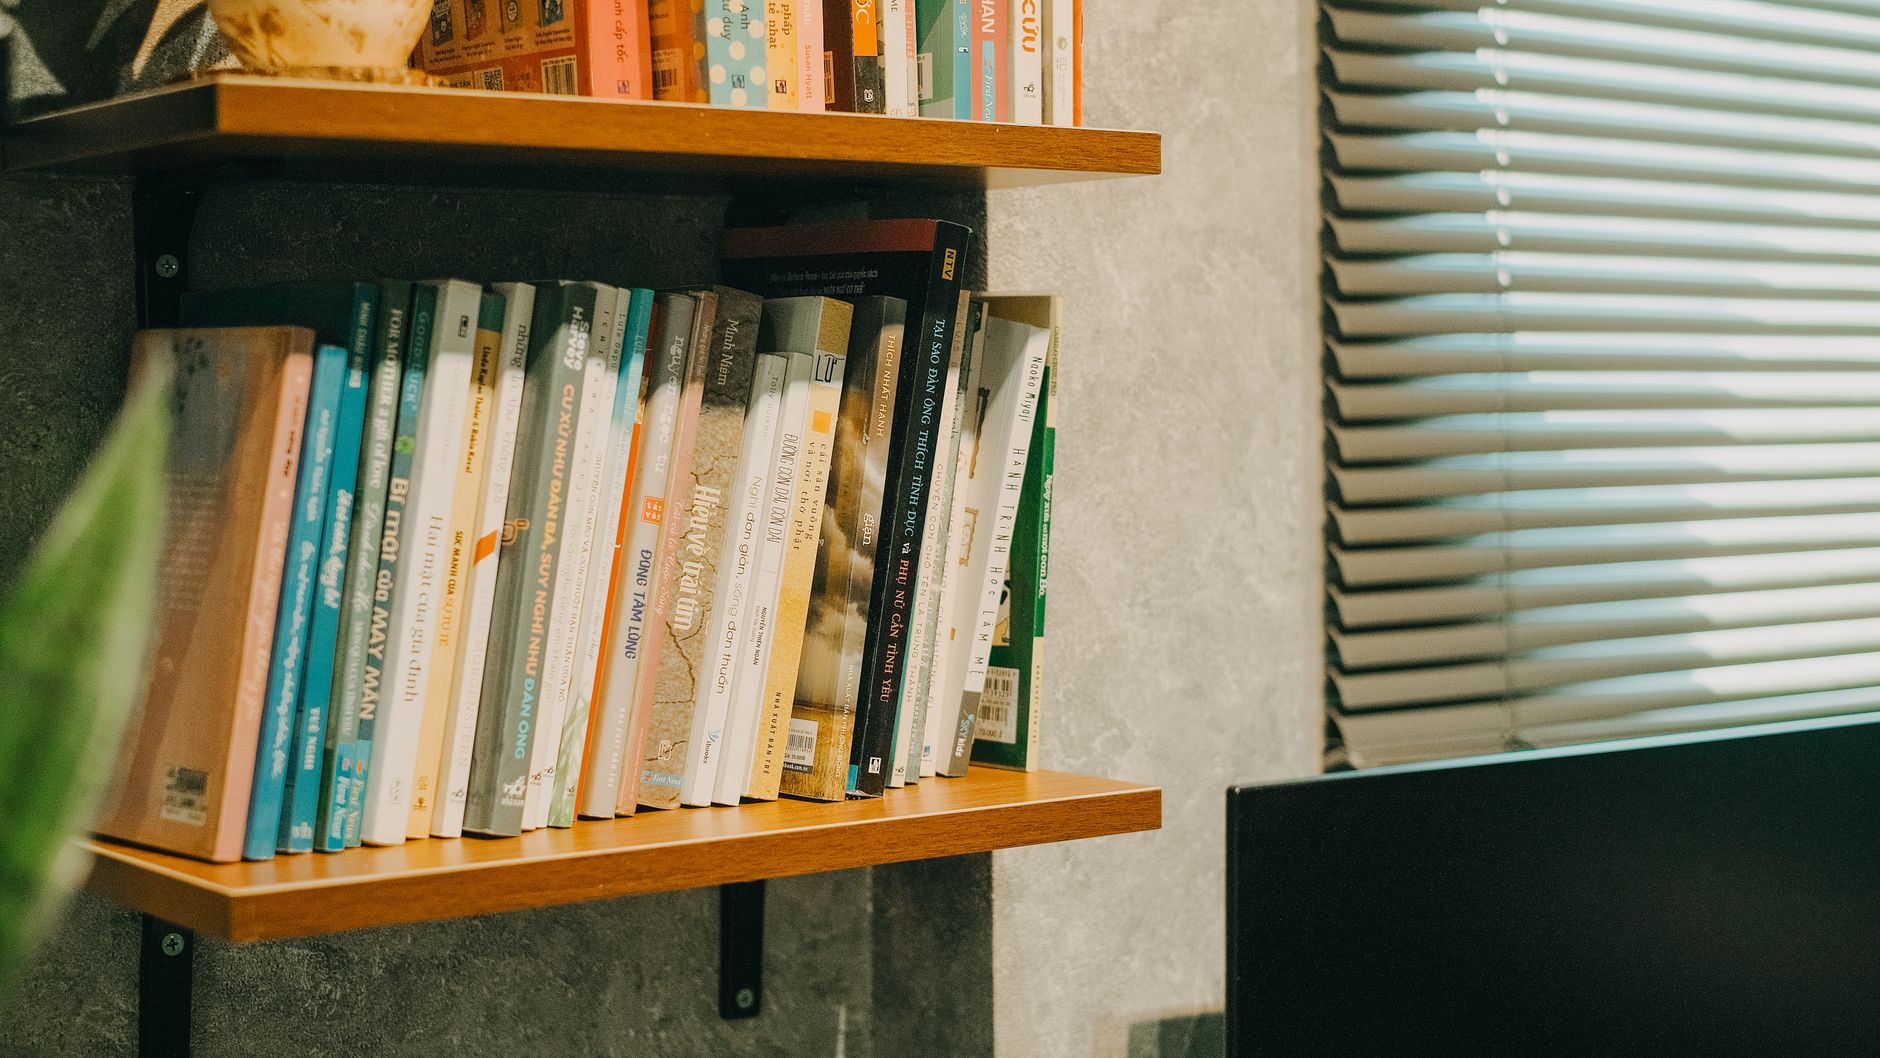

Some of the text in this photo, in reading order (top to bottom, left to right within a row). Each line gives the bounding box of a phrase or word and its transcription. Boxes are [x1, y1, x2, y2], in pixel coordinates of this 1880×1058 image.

[721, 16, 733, 40] duy
[740, 4, 750, 30] Anh
[782, 4, 792, 36] pháp
[767, 20, 778, 49] nhạt
[616, 44, 629, 63] tốc
[804, 74, 812, 99] Hyatt
[942, 250, 953, 279] NTV
[387, 307, 402, 344] FOR
[930, 318, 944, 338] TẠI
[510, 323, 529, 368] những
[716, 317, 739, 386] Minh Niệm
[928, 341, 941, 364] SAO
[767, 375, 779, 399] Tolly
[874, 334, 896, 438] THÍCH NHẤT HẠNH
[924, 367, 940, 394] ĐÀN
[1017, 354, 1042, 424] Naoko Miyaji
[920, 397, 936, 426] ÔNG
[468, 429, 479, 450] Robin
[779, 432, 798, 466] ĐƯỜNG
[806, 440, 817, 457] và
[913, 429, 931, 470] THÍCH
[464, 450, 475, 474] Koval
[775, 466, 792, 486] CÒN
[1004, 446, 1025, 492] HÀNH
[746, 475, 763, 510] Nghĩ
[803, 442, 828, 542] cái sân vuông
[908, 474, 924, 507] TÌNH
[930, 462, 944, 512] CHUYỆN
[1041, 473, 1052, 500] Ngày
[742, 511, 758, 541] đơn
[769, 506, 785, 527] CÒN
[860, 512, 876, 547] giận
[902, 510, 917, 537] DỤC
[926, 514, 937, 540] CON
[992, 502, 1014, 555] TRÌNH
[766, 527, 783, 545] DÀI
[901, 541, 911, 555] và
[535, 552, 553, 591] SUY
[672, 483, 723, 633] Hiểu về trái tim
[895, 558, 910, 586] PHỤ
[1039, 555, 1047, 577] con
[623, 548, 653, 661] ĐONG TẤM LÒNG
[726, 582, 744, 617] sống
[893, 588, 908, 611] NỮ
[367, 606, 389, 658] MAY
[722, 619, 738, 650] đơn
[889, 612, 906, 639] CẦN
[975, 608, 993, 642] LÀM
[911, 622, 924, 659] TRUNG
[884, 642, 900, 675] TÌNH
[358, 665, 385, 722] MẮN
[880, 677, 896, 705] YÊU
[906, 664, 920, 704] THÀNH
[457, 638, 485, 768] MORGENSTERN
